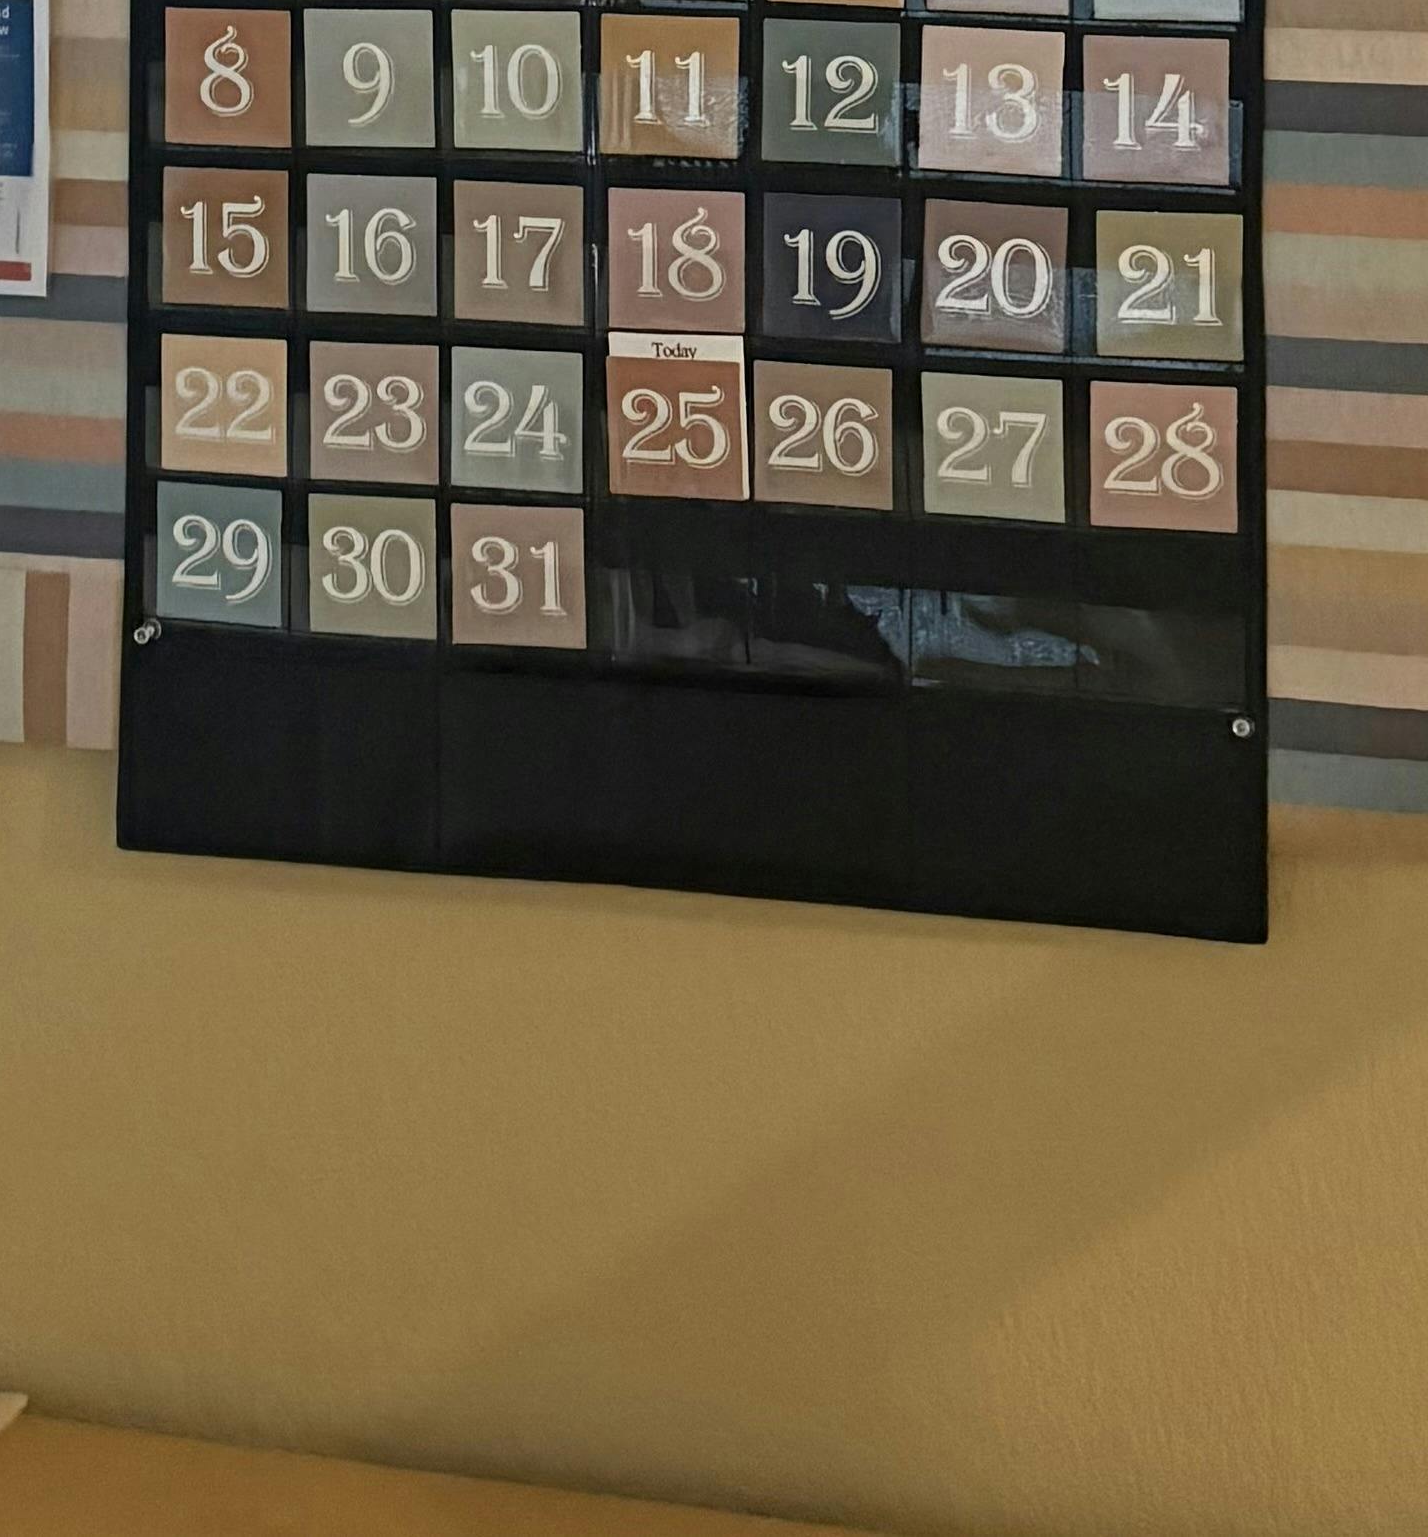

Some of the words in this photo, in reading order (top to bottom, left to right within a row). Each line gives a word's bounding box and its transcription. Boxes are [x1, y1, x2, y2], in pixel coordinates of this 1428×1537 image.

[198, 26, 252, 117] 8
[342, 43, 396, 125] 9
[471, 41, 562, 119] 10
[625, 48, 707, 125] 11
[784, 54, 879, 132] 12
[944, 64, 1041, 142] 13
[1106, 73, 1207, 151] 14
[181, 195, 269, 279] 15
[326, 207, 418, 285] 16
[474, 214, 565, 292] 17
[628, 207, 726, 302] 18
[784, 228, 883, 319] 19
[938, 235, 1052, 317] 20
[1119, 245, 1222, 327] 21
[651, 341, 698, 359] Today
[175, 367, 276, 445] 22
[322, 373, 425, 451] 23
[463, 380, 566, 458] 24
[622, 388, 730, 468] 25
[768, 395, 881, 476] 26
[938, 407, 1047, 485] 27
[1104, 401, 1224, 498] 28
[173, 516, 273, 601] 29
[322, 529, 423, 605] 30
[471, 538, 568, 617] 31
